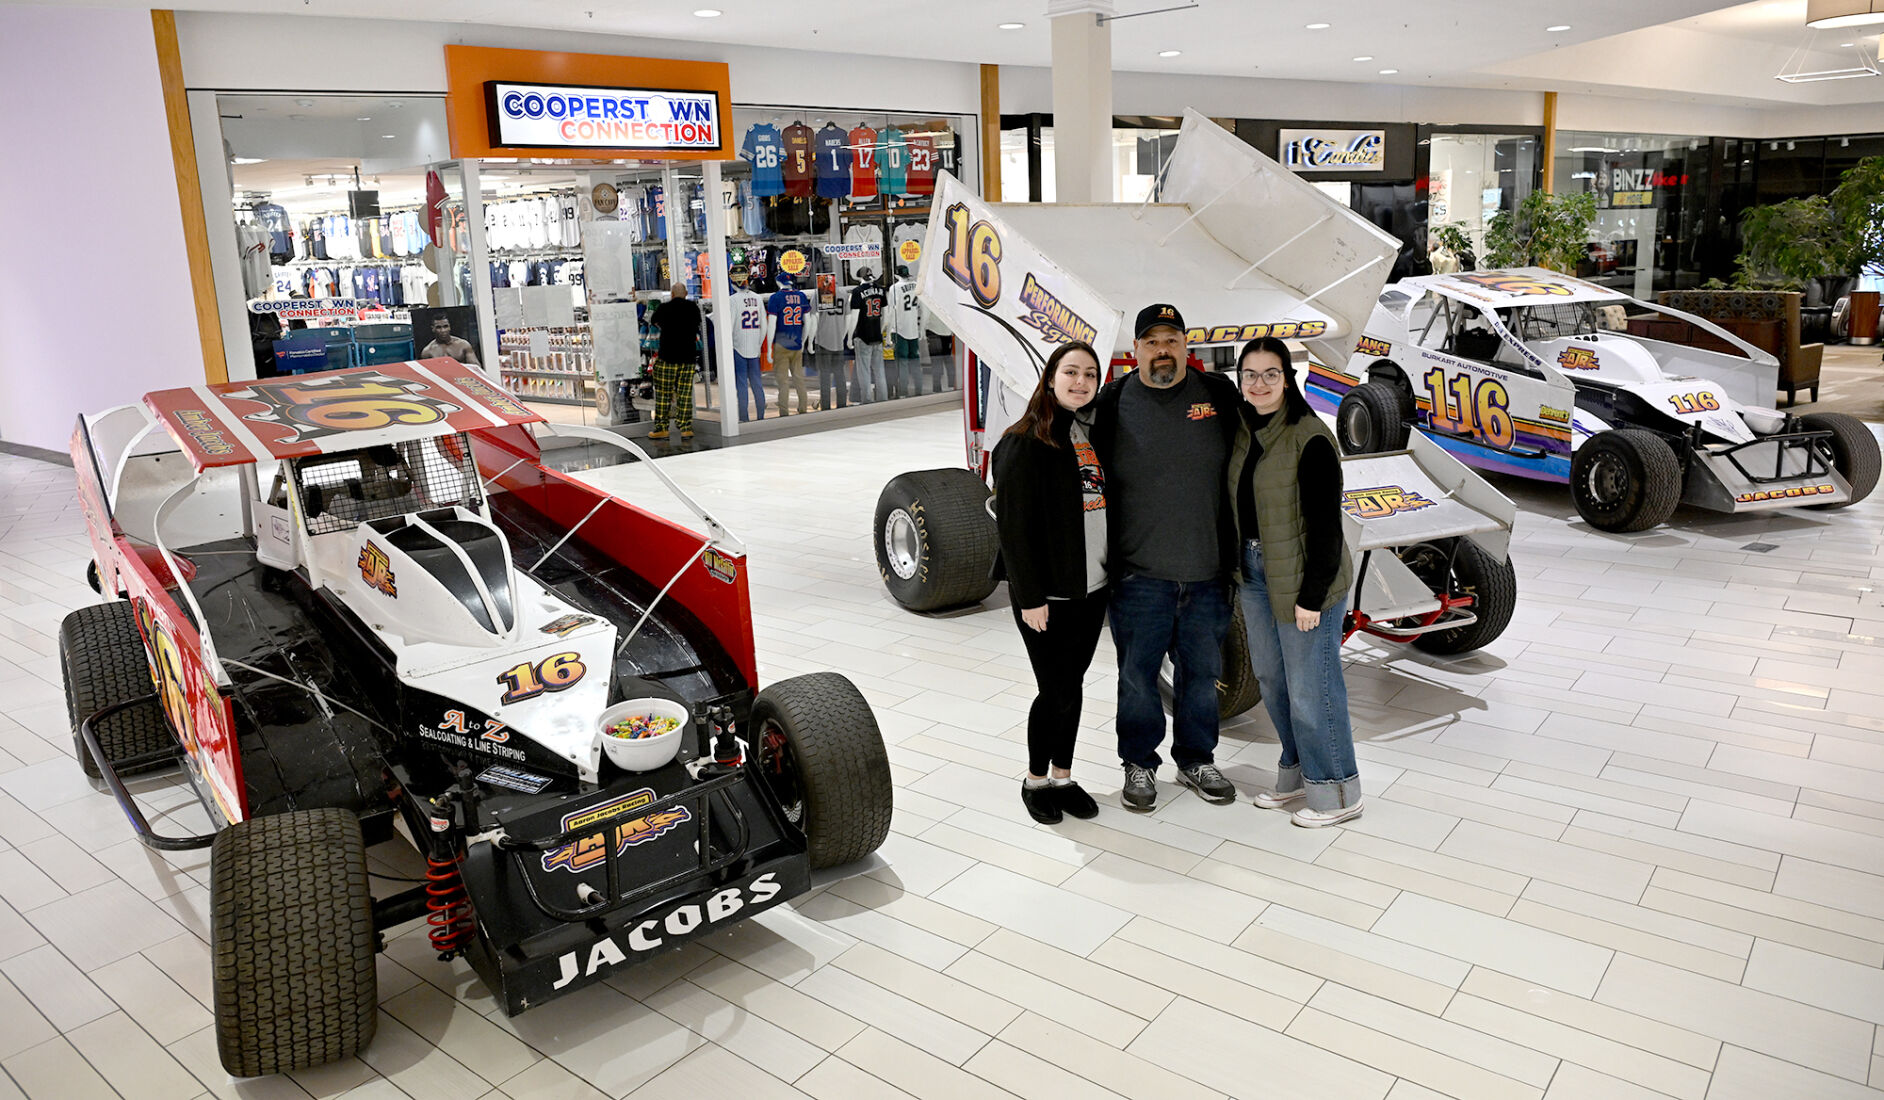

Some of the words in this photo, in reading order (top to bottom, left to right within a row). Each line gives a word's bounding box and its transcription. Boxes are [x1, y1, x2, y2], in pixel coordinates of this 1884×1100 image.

[503, 93, 711, 122] COOPERSTWN
[560, 121, 712, 143] CONNECTION
[755, 145, 777, 168] 26
[795, 150, 805, 173] 5
[830, 149, 839, 171] 1
[858, 147, 873, 168] 17
[888, 148, 900, 168] 10
[912, 148, 930, 171] 23
[942, 149, 954, 168] 11
[722, 191, 732, 204] 17
[825, 243, 880, 253] COOPERSTWN
[839, 251, 880, 259] CONNECTION
[943, 202, 1002, 309] 16
[276, 280, 292, 293] 24
[253, 299, 354, 311] COOPERSTWN
[785, 295, 800, 304] SOTO
[866, 299, 881, 317] 13
[1019, 272, 1098, 346] PERFORMANCE
[280, 308, 354, 318] CONNECTION
[741, 310, 760, 329] 22
[783, 306, 802, 325] 22
[1160, 307, 1174, 316] 16
[1184, 320, 1327, 346] ACOBS
[1503, 333, 1542, 366] EXPRESS
[1563, 352, 1590, 369] AJR
[1421, 352, 1455, 366] BURKART
[1457, 362, 1508, 381] AUTOMOTIVE
[274, 382, 442, 431] 16
[1193, 406, 1211, 420] AJR
[1423, 366, 1515, 453] 116
[1669, 391, 1720, 414] 116
[1736, 484, 1834, 503] JACOBS
[1356, 494, 1408, 518] AJR
[496, 652, 587, 706] 16
[438, 709, 470, 734] A
[469, 720, 480, 730] to
[481, 719, 510, 743] Z
[419, 724, 467, 747] SEALCOATING
[468, 738, 474, 749] &
[474, 738, 492, 753] LINE
[492, 742, 526, 761] STRIPING
[573, 814, 595, 826] Aaron
[596, 806, 621, 820] Jacobs
[621, 798, 646, 812] Racing
[553, 872, 781, 990] JACOBS
